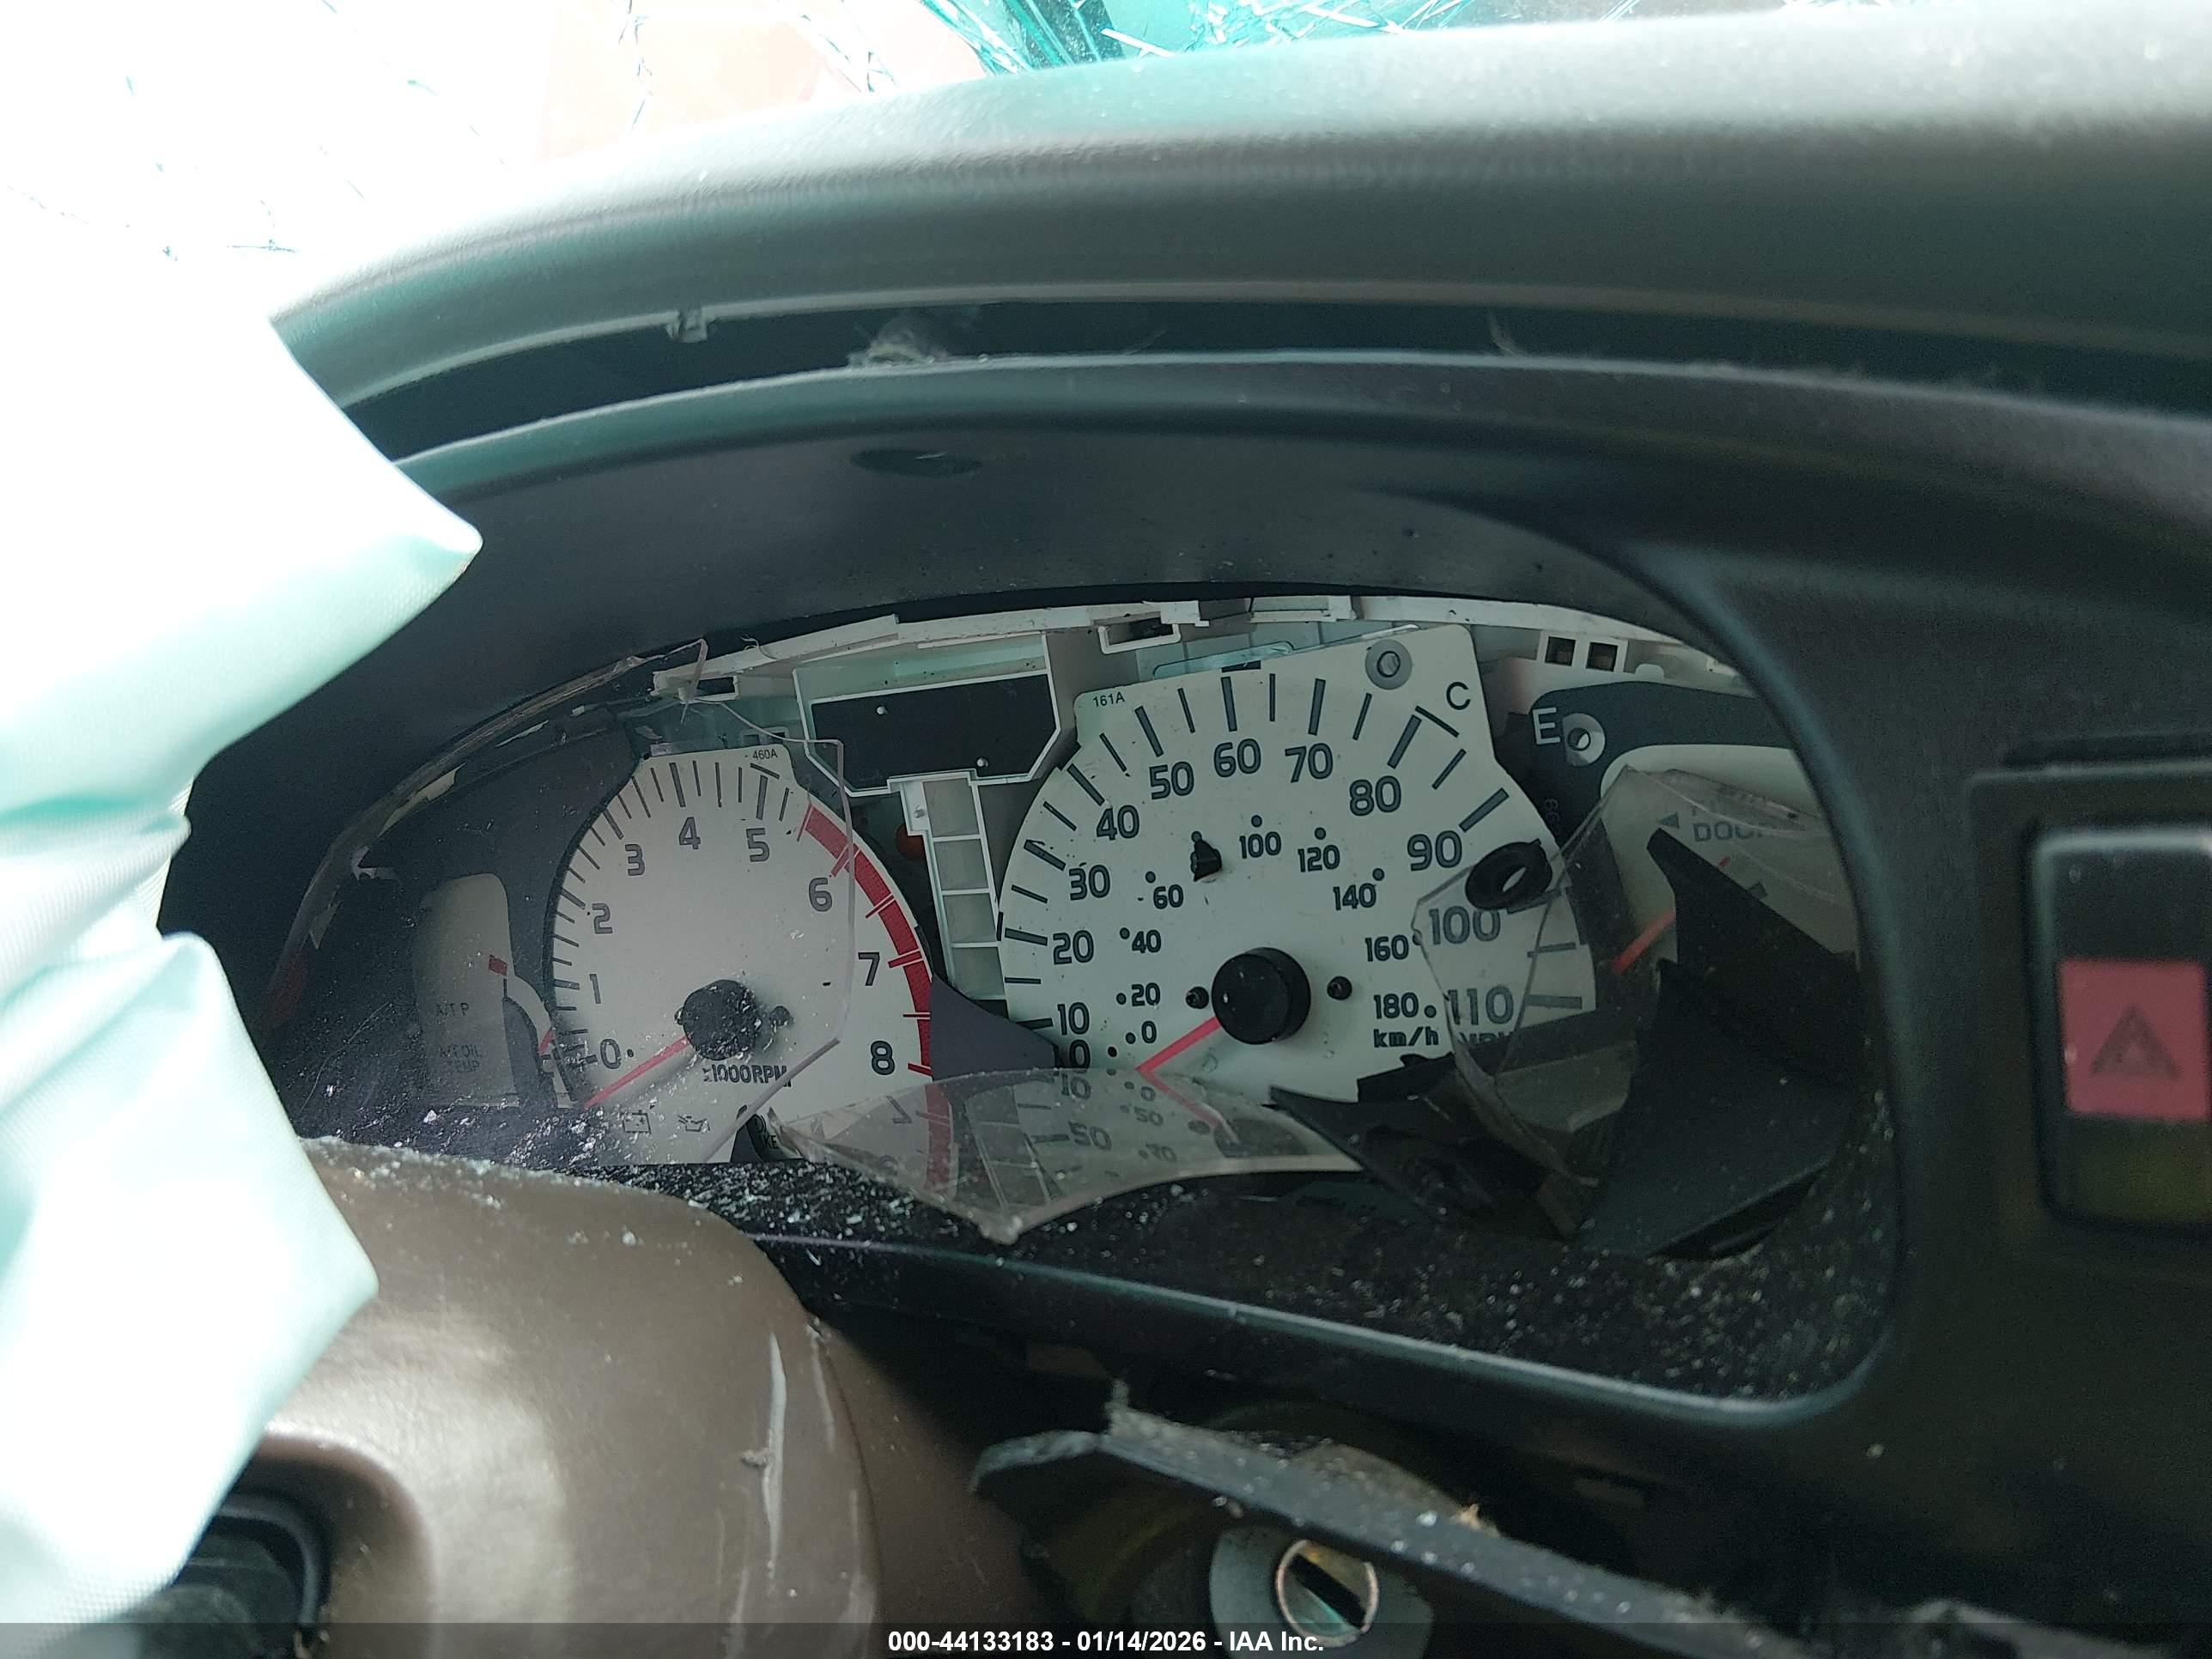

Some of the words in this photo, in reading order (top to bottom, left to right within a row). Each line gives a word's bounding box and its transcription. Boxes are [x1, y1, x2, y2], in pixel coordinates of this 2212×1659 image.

[1092, 691, 1125, 708] 161A
[1446, 682, 1471, 710] C
[1532, 707, 1561, 745] E
[751, 748, 779, 761] 460A
[1213, 738, 1261, 777] 60
[1285, 743, 1334, 783] 70
[1149, 762, 1194, 799] 50
[1349, 775, 1401, 817] 80
[678, 817, 701, 850] 4
[1096, 805, 1140, 841] 40
[624, 843, 646, 877] 3
[746, 828, 770, 862] 5
[1239, 831, 1282, 860] 100
[1297, 845, 1340, 873] 120
[1407, 830, 1462, 872] 90
[808, 878, 834, 912] 6
[1068, 865, 1110, 901] 30
[1153, 884, 1184, 909] 60
[1333, 883, 1376, 911] 140
[592, 903, 613, 934] 2
[1428, 906, 1501, 945] 100
[1053, 930, 1095, 965] 20
[1131, 929, 1162, 954] 40
[1364, 934, 1409, 963] 160
[858, 951, 881, 987] 7
[589, 973, 602, 1004] 1
[1131, 982, 1160, 1006] 20
[1057, 1002, 1091, 1036] 10
[1373, 993, 1419, 1019] 180
[1447, 985, 1514, 1026] 110
[1141, 1020, 1158, 1043] 0
[1374, 1026, 1439, 1048] km/h
[600, 1039, 622, 1070] 0
[870, 1040, 895, 1075] 8
[1068, 1039, 1091, 1070] 0
